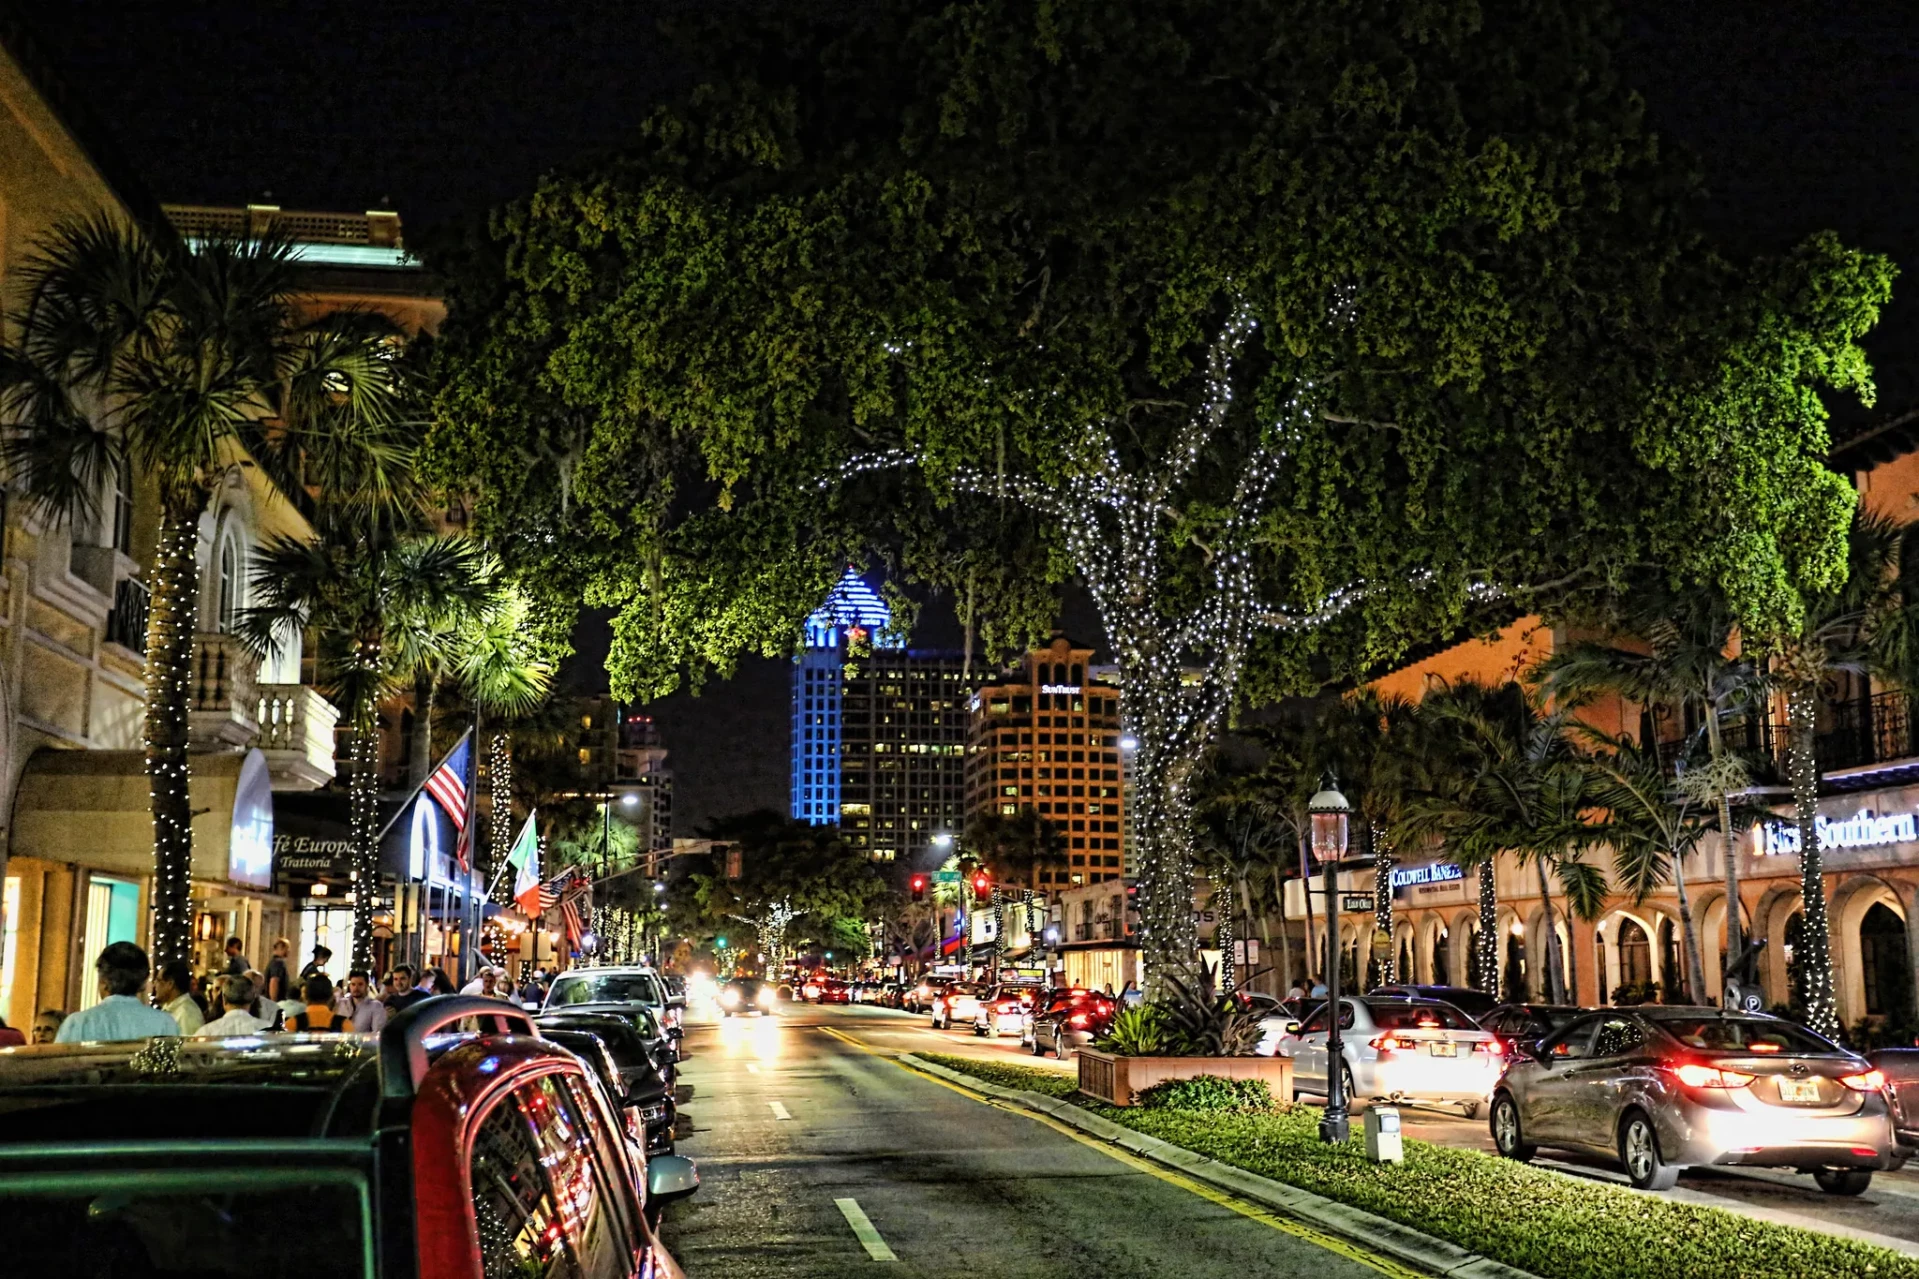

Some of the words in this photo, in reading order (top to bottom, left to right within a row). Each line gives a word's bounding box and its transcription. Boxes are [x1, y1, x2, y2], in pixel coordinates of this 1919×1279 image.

[1764, 821, 1802, 855] Firs
[1814, 808, 1917, 852] Southern
[279, 854, 331, 869] Trattoria
[1392, 867, 1430, 887] COLDWELL
[1748, 998, 1758, 1009] P
